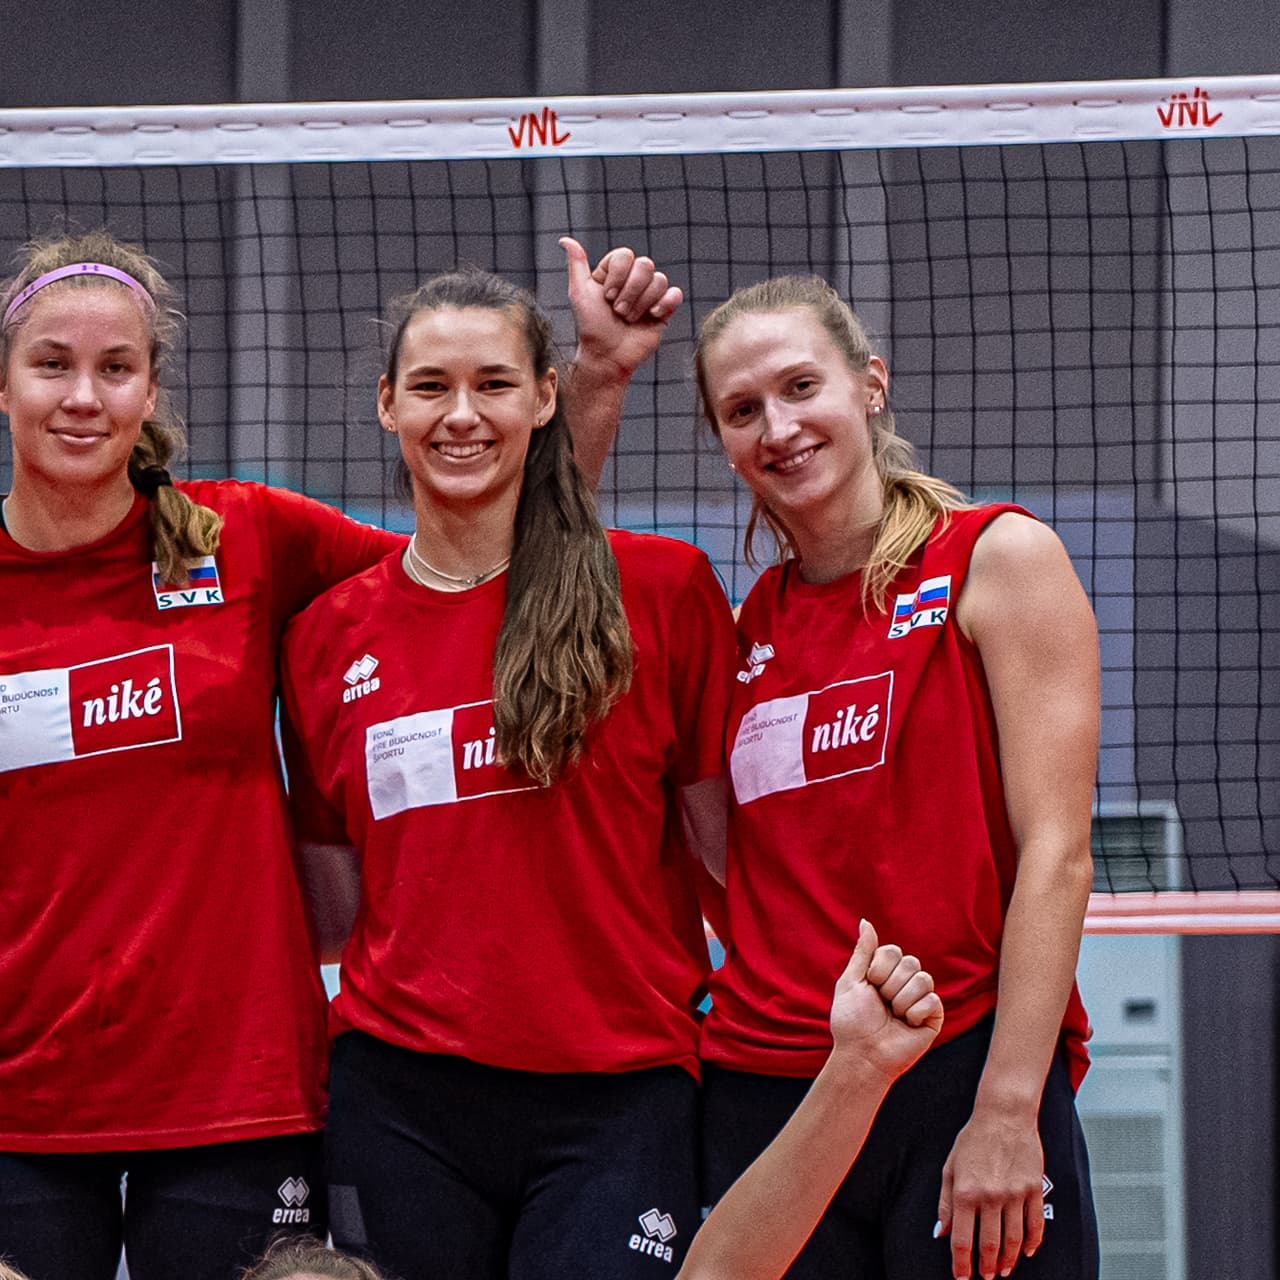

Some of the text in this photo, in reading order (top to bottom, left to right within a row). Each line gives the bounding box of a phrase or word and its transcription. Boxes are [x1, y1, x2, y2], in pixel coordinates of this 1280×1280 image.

[508, 106, 570, 147] VNL
[1157, 87, 1223, 128] VNL
[158, 590, 223, 608] SVK
[890, 609, 946, 637] SVK
[82, 676, 163, 728] niké
[462, 727, 496, 770] ni
[811, 703, 880, 753] niké
[272, 1208, 311, 1224] errea
[628, 1233, 673, 1263] errea
